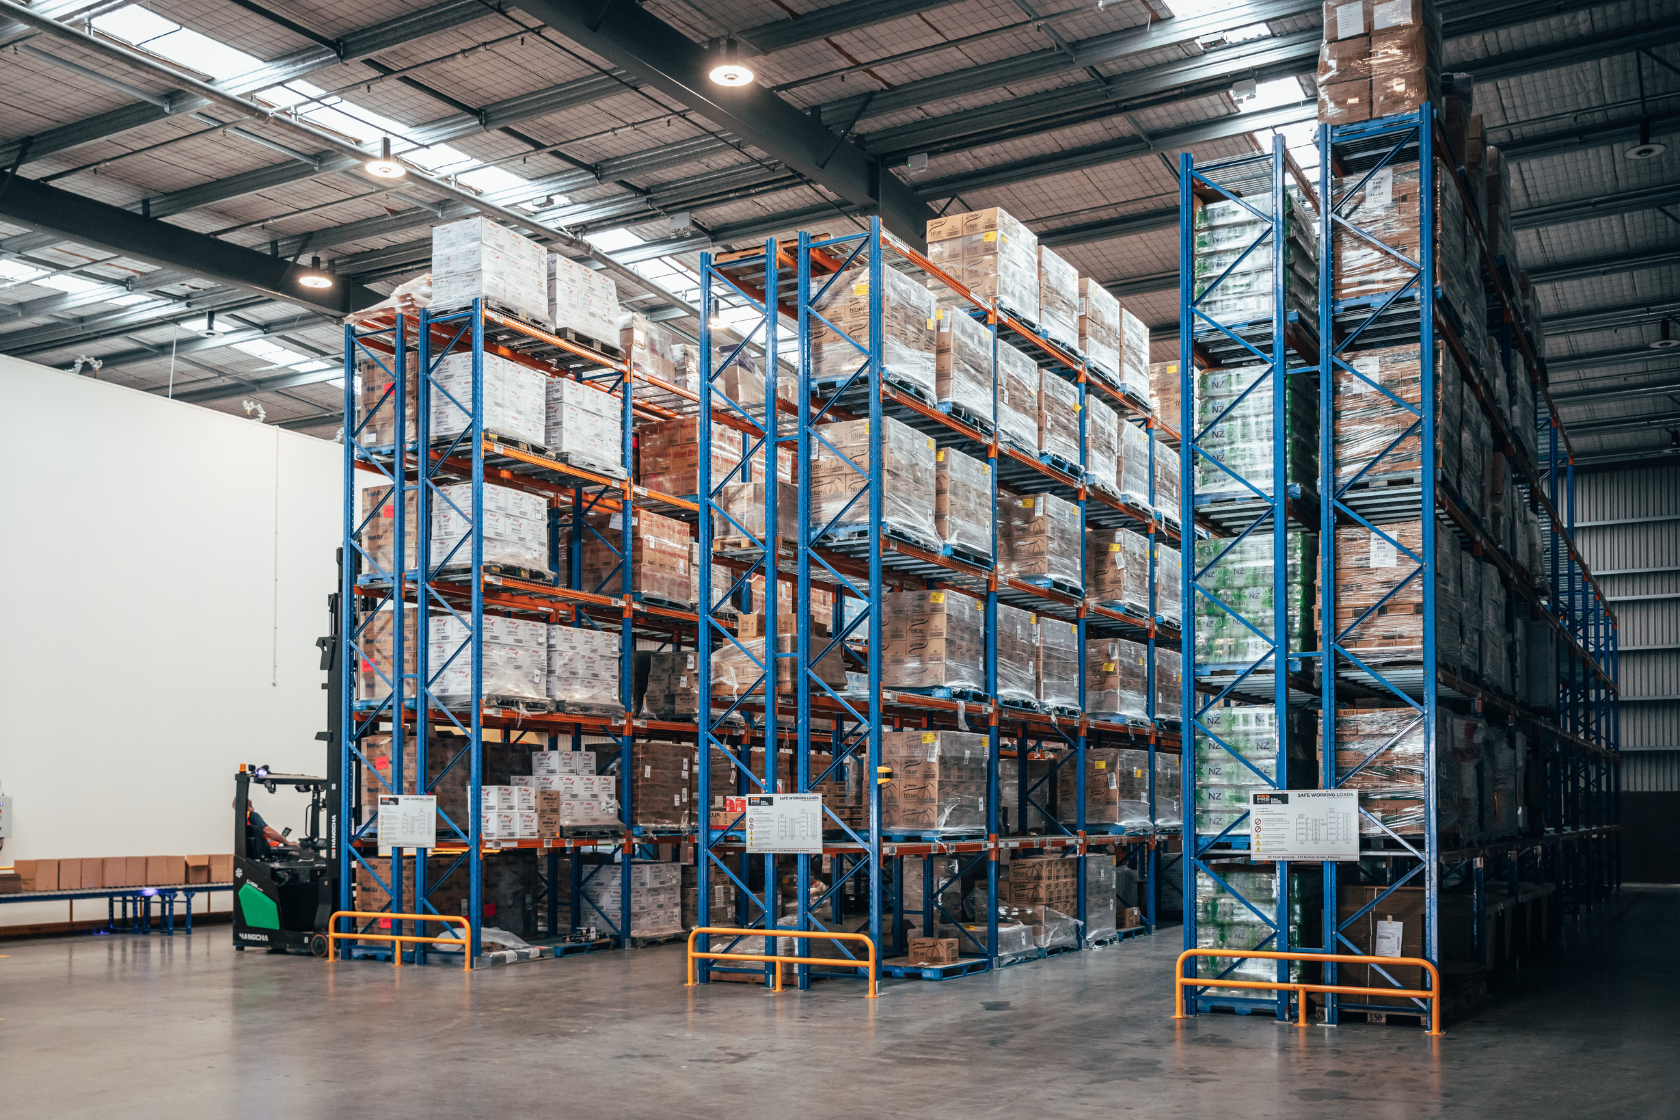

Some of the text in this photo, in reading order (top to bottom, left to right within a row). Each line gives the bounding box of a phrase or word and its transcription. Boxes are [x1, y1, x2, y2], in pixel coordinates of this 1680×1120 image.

[1212, 381, 1225, 389] NZ
[1256, 742, 1269, 750] NZ
[239, 932, 268, 941] HANGCHA
[1369, 1013, 1382, 1021] $50
